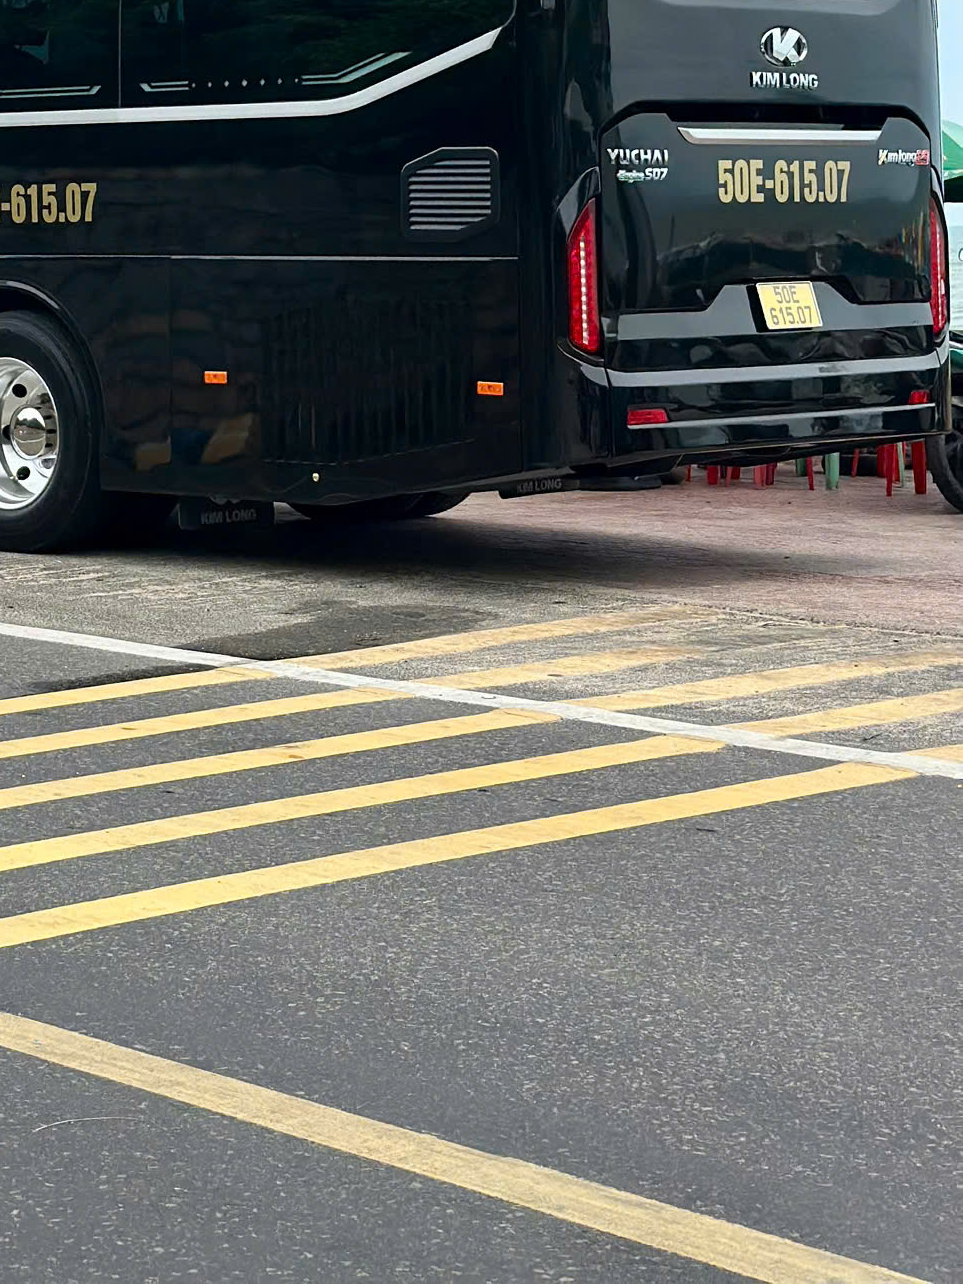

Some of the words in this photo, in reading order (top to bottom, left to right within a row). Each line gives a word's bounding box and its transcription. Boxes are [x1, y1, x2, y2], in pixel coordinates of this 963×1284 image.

[751, 71, 780, 88] KIM
[782, 72, 819, 89] LONG
[606, 148, 669, 165] YUCHAI
[717, 159, 851, 203] 50E-615.07
[772, 285, 800, 304] 50E
[769, 305, 813, 326] 615.07
